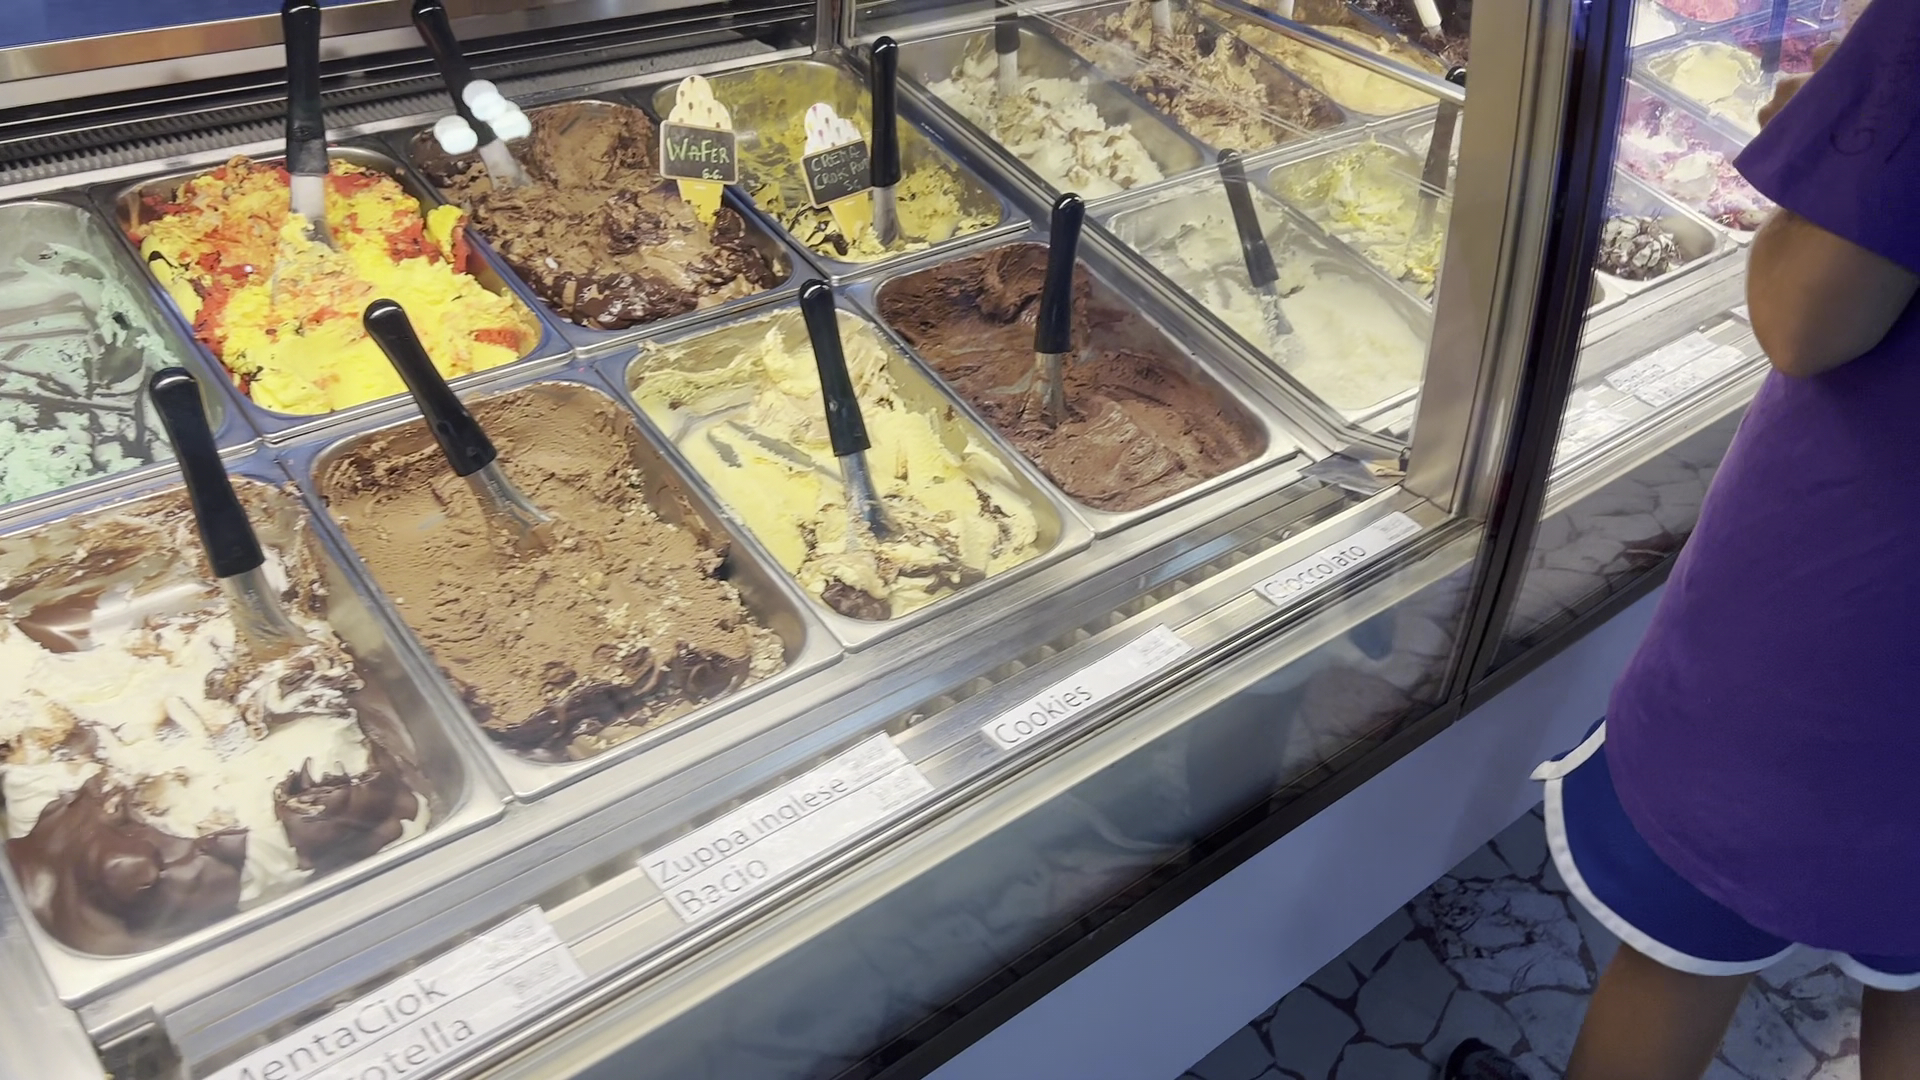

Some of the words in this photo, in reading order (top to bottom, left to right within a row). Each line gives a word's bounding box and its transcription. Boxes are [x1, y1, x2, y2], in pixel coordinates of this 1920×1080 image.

[666, 138, 730, 164] WAFER
[811, 146, 860, 172] CREMA
[1264, 545, 1367, 599] Cioccolato
[994, 686, 1092, 744] Cookies
[651, 828, 750, 884] Zuppa
[751, 775, 848, 835] inglese
[675, 859, 769, 915] Bacio
[349, 1018, 474, 1080] otella
